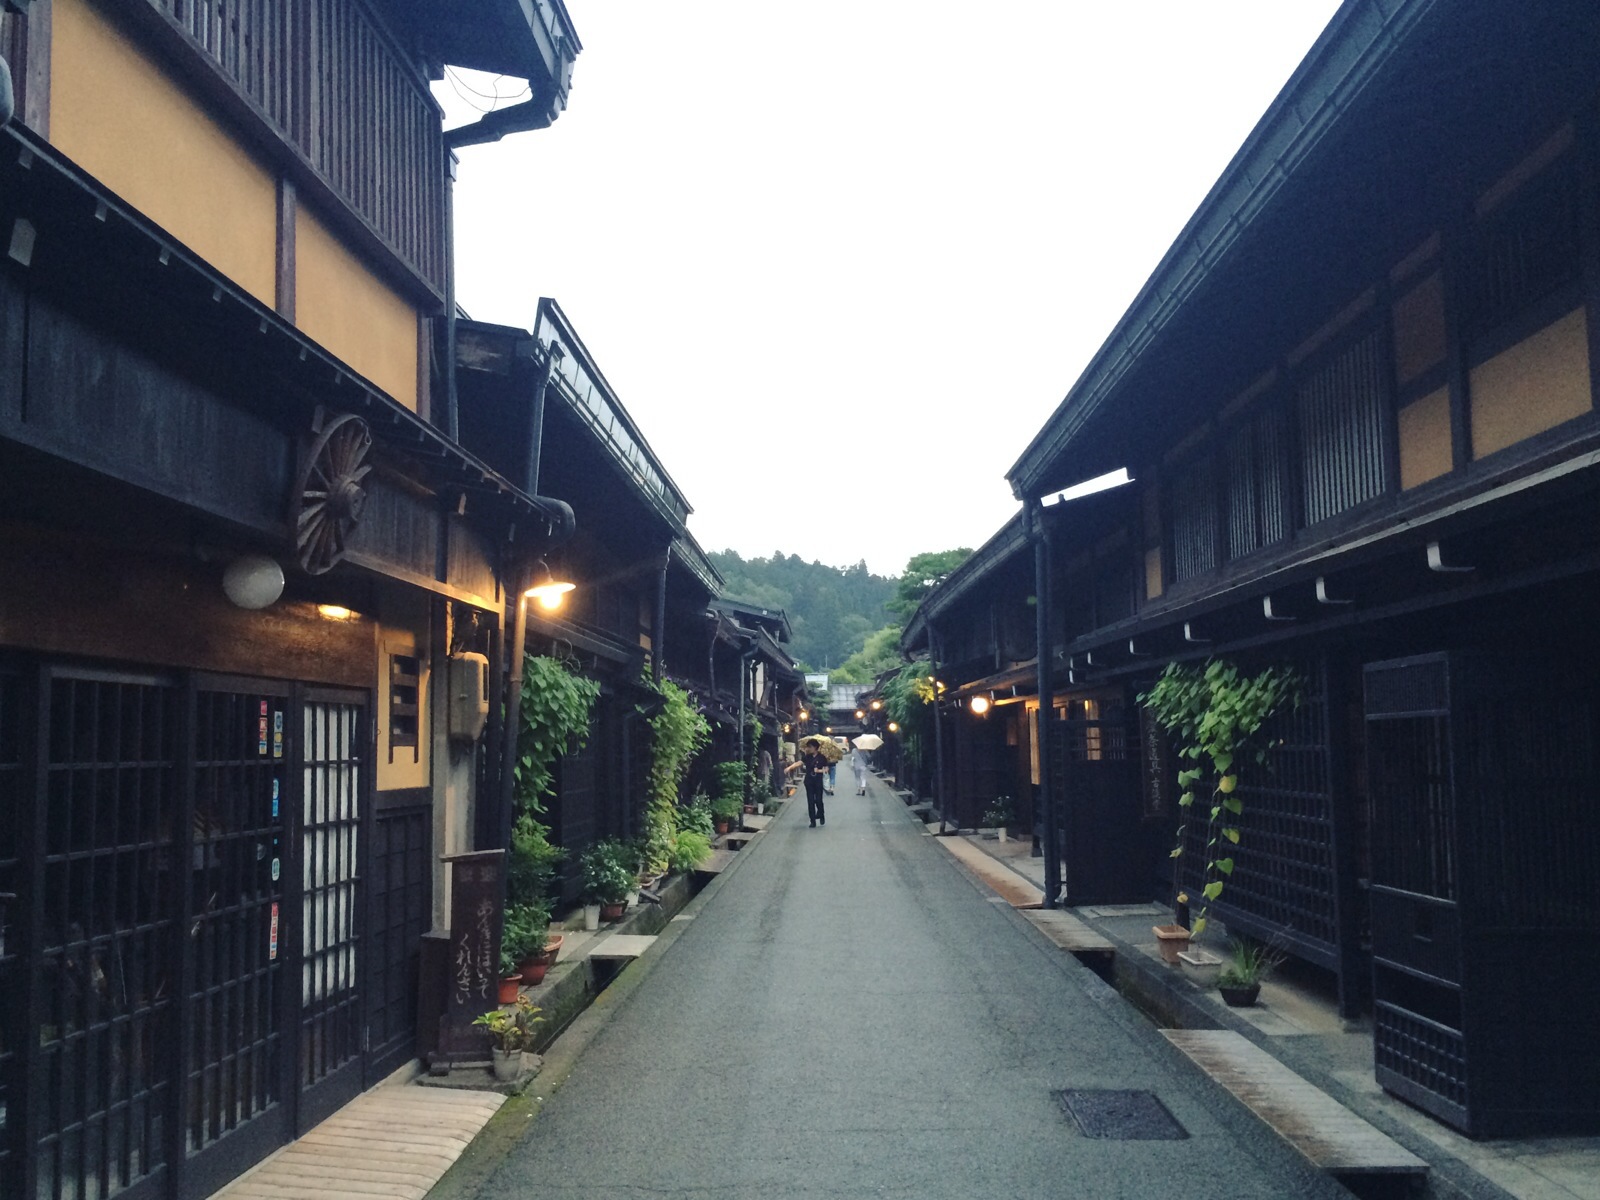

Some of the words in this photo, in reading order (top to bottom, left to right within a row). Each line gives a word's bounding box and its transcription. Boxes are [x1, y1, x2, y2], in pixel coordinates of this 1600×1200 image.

[456, 933, 472, 1005] くれんさい
